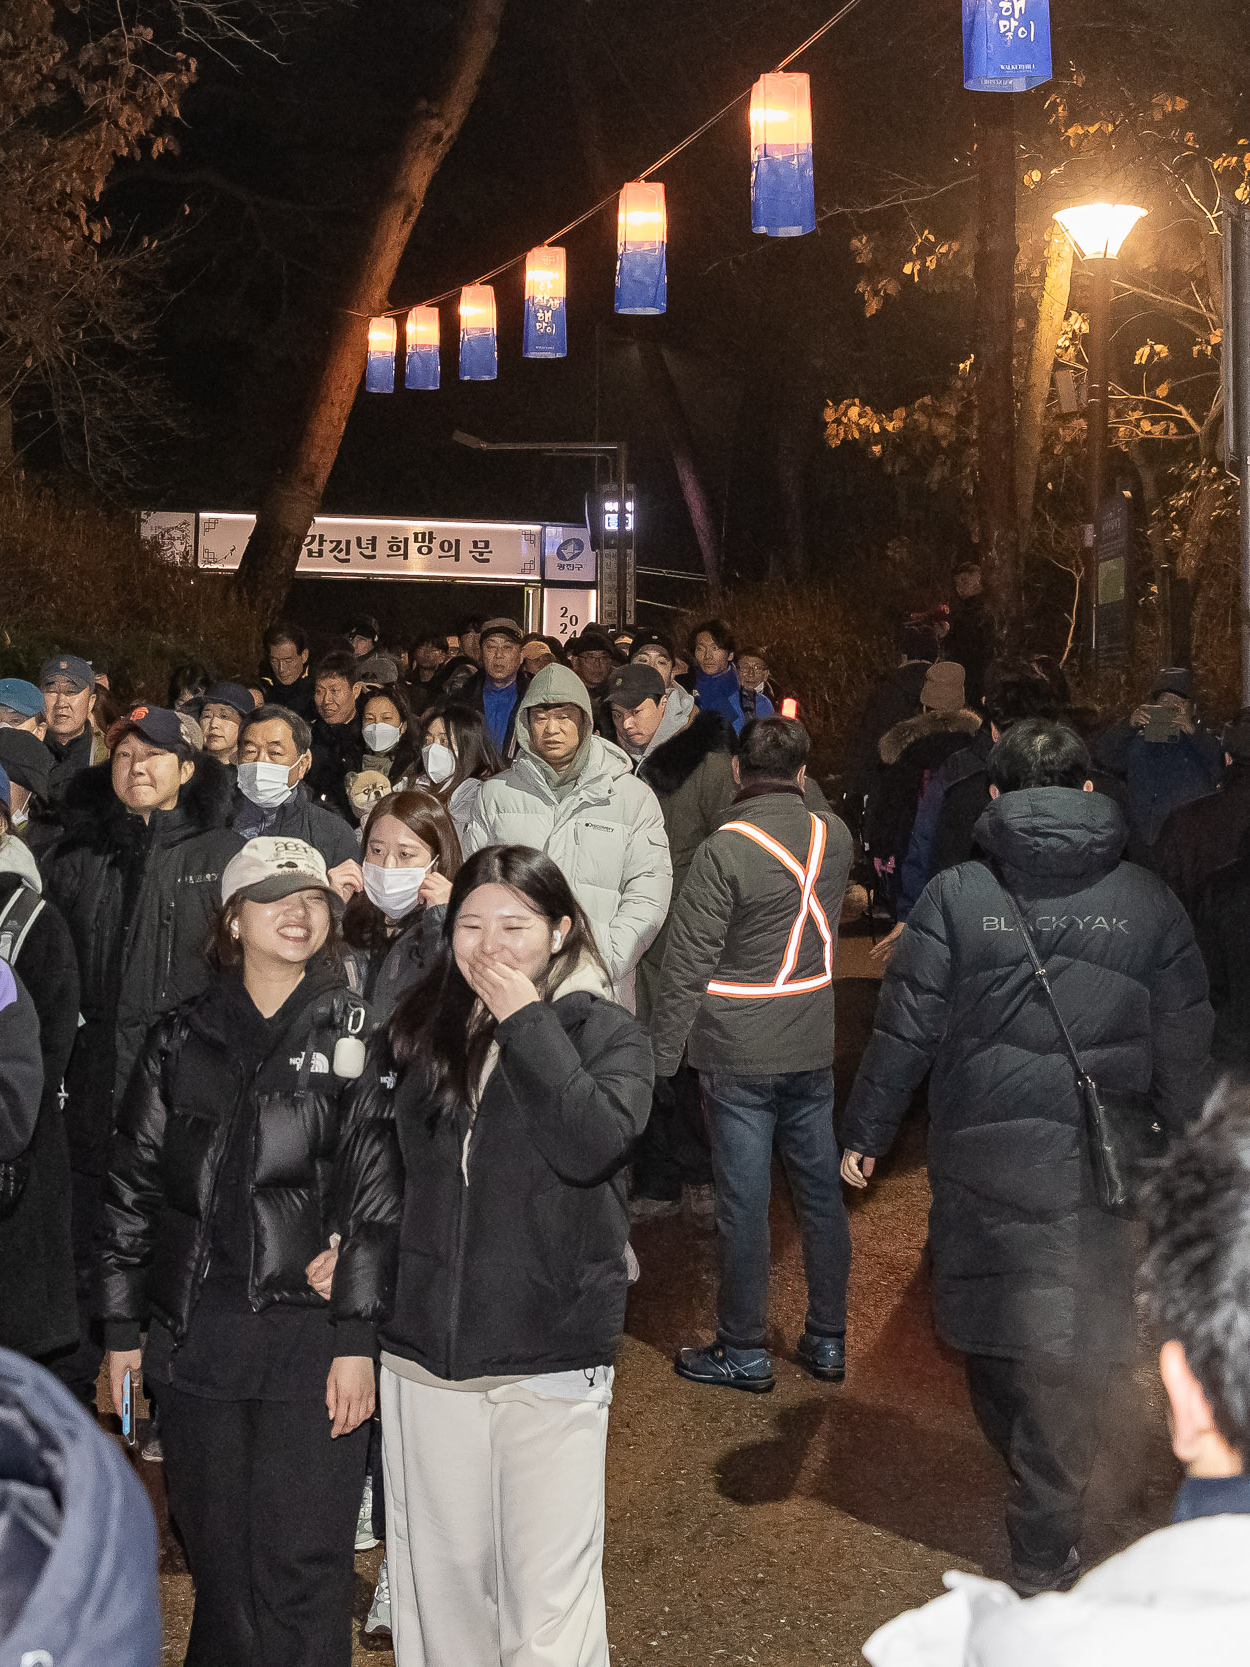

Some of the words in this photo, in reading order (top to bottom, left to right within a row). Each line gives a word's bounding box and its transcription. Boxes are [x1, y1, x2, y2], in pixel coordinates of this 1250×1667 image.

[303, 533, 377, 563] 갑진년
[386, 531, 461, 562] 희망의
[469, 540, 493, 563] 문
[557, 563, 584, 571] 광진구
